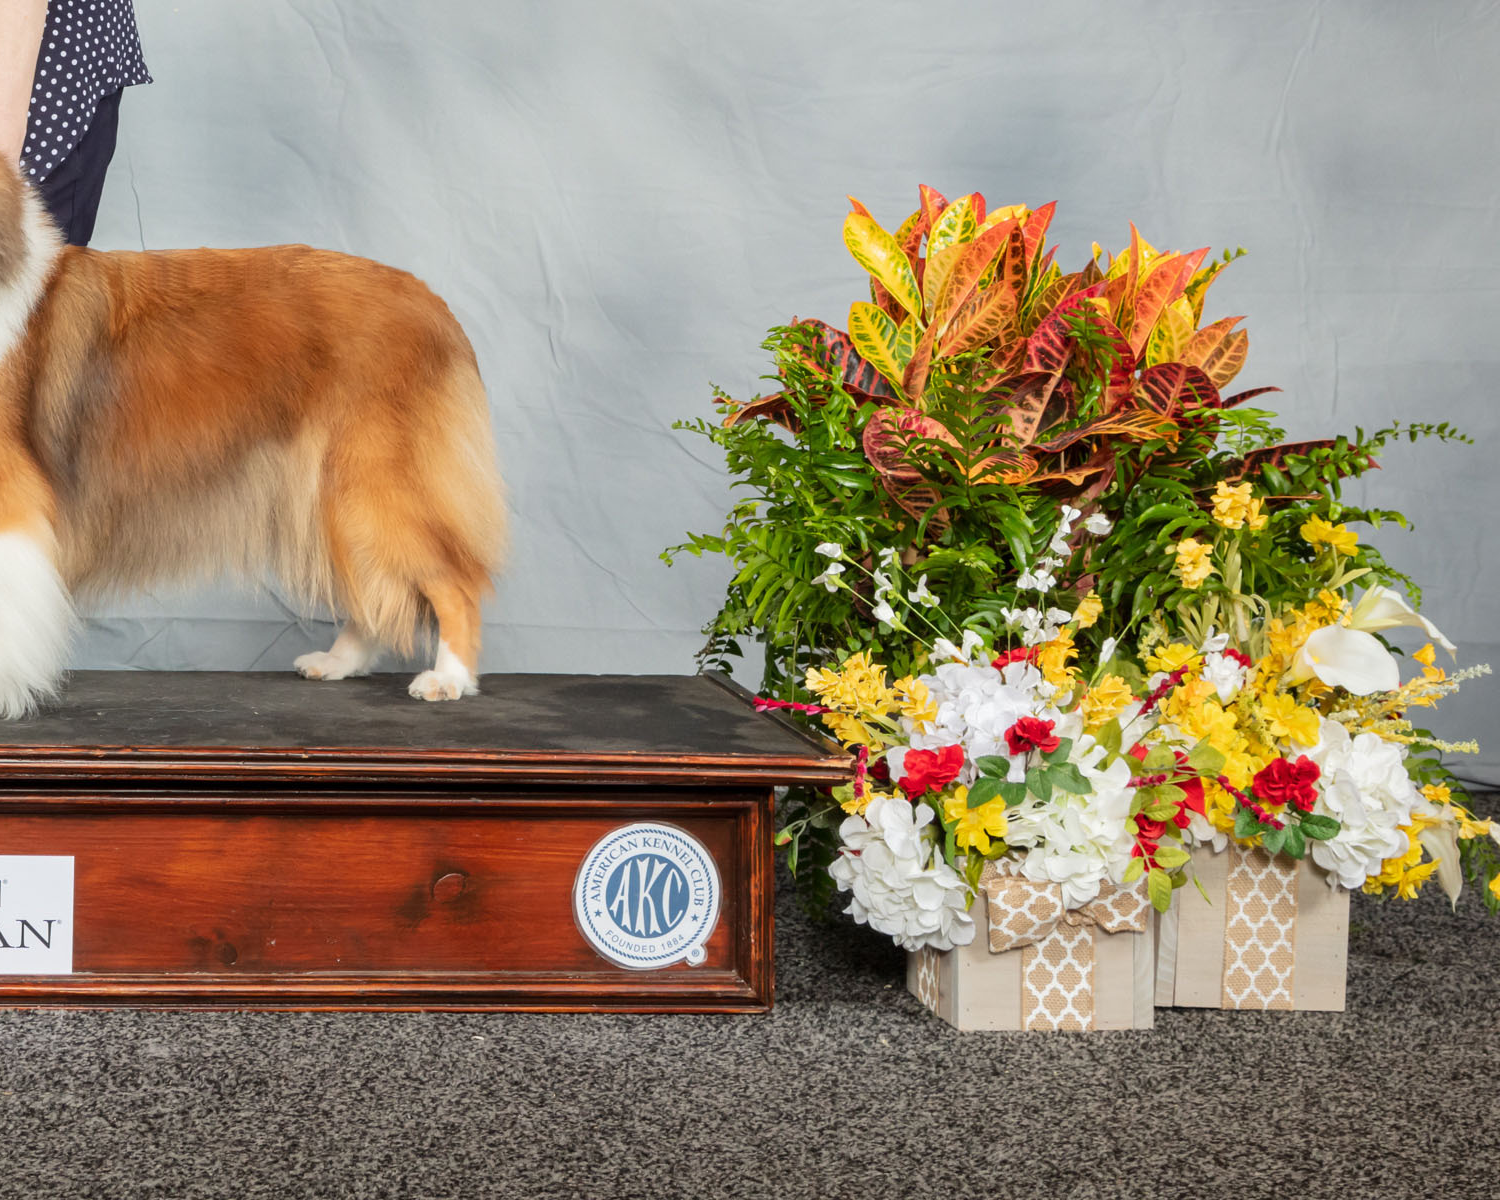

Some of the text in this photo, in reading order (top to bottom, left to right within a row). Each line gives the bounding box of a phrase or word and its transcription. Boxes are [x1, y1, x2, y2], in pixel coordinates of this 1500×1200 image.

[591, 837, 705, 907] AMERICAN KENNEL CLUB
[609, 856, 684, 937] AKC
[605, 930, 685, 954] FOUNDED 1884
